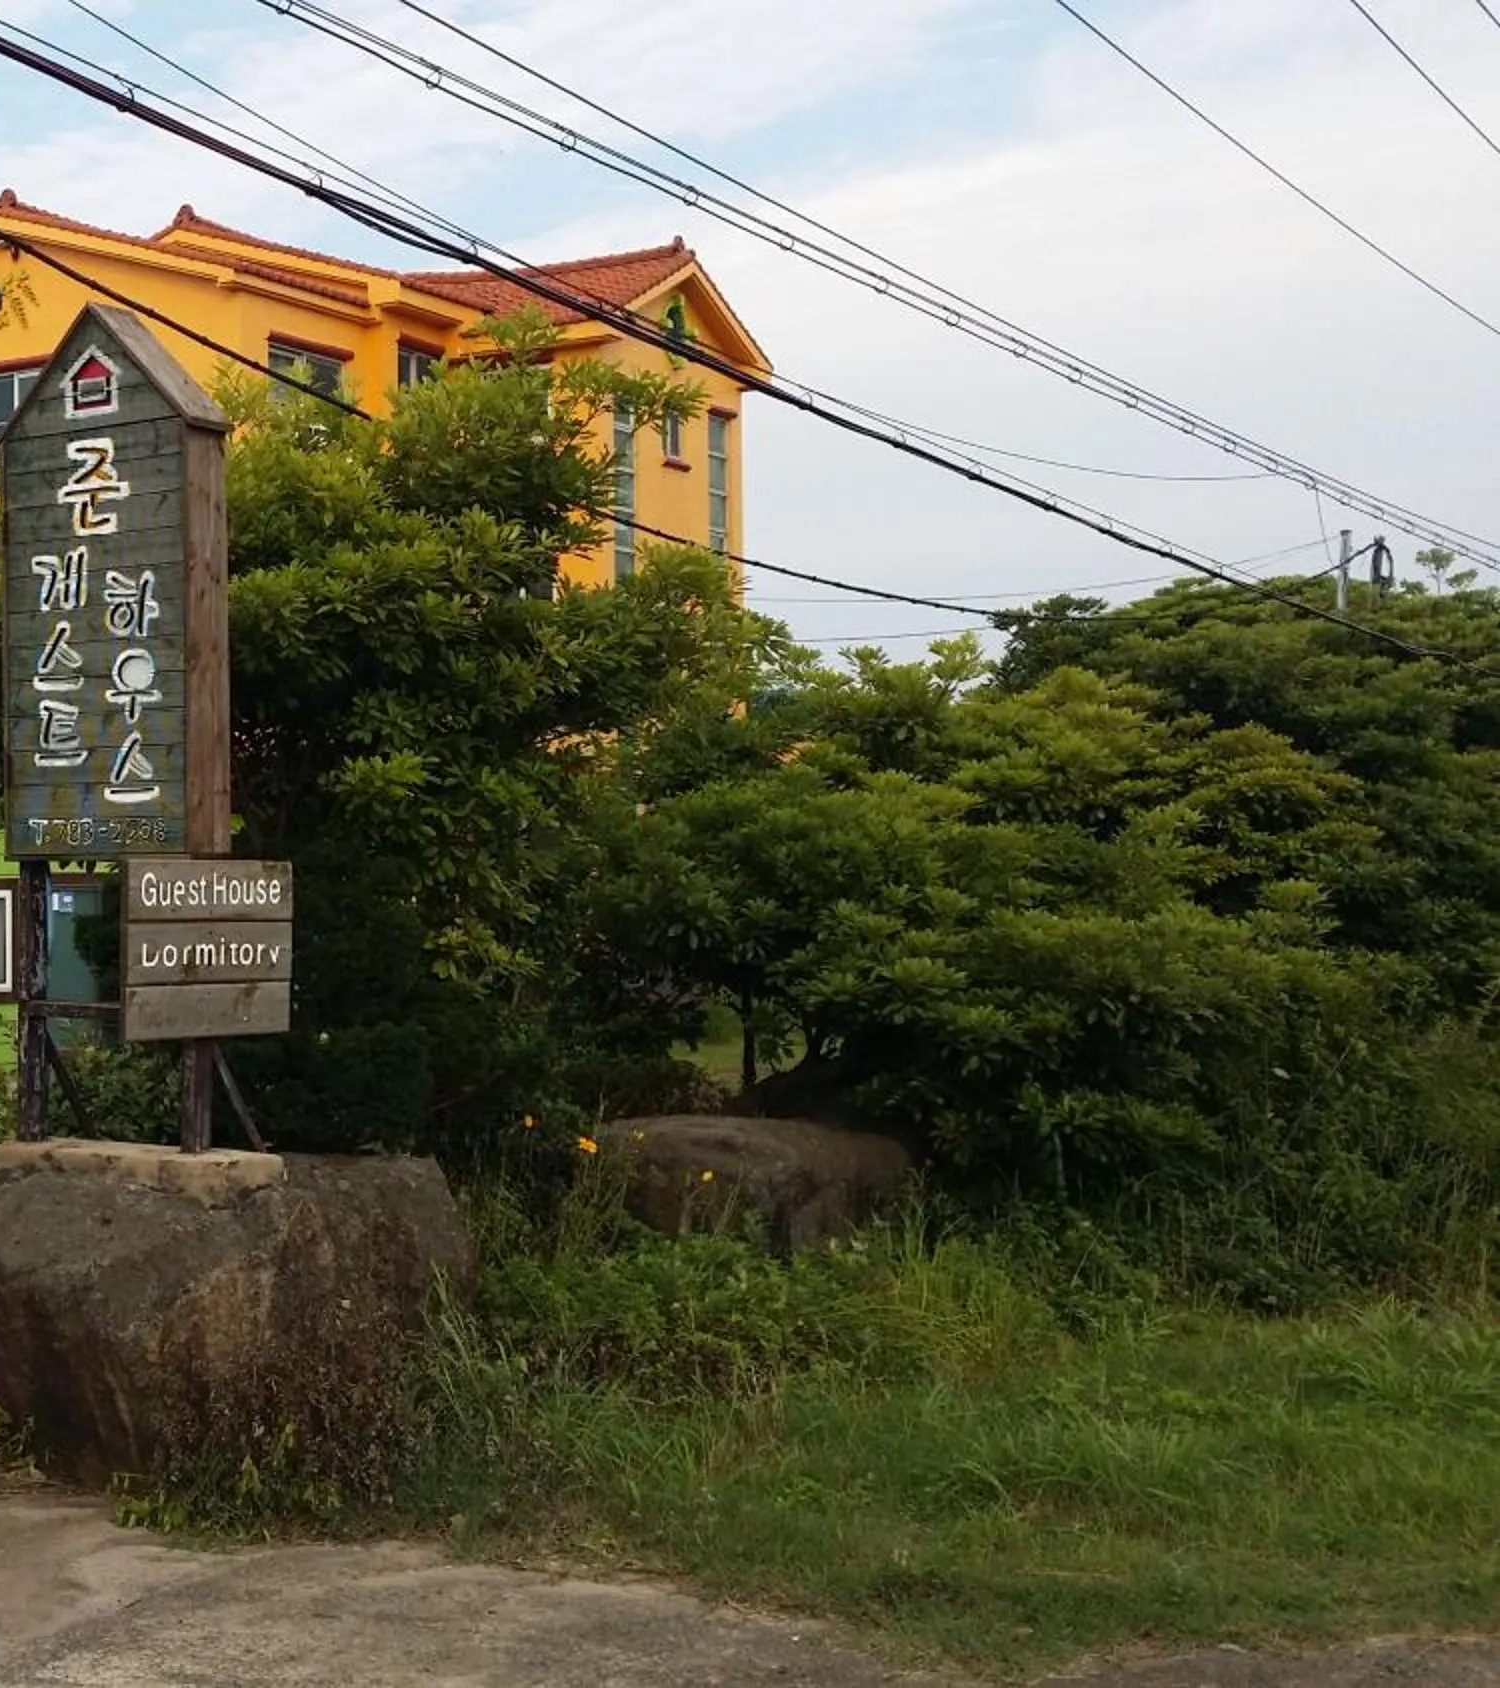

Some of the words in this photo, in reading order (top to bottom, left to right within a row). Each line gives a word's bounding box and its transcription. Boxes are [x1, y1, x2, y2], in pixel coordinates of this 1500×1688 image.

[57, 437, 130, 536] 준
[31, 545, 89, 768] 게스트
[104, 569, 162, 803] 하우스
[141, 872, 207, 907] Guest
[213, 872, 282, 906] House
